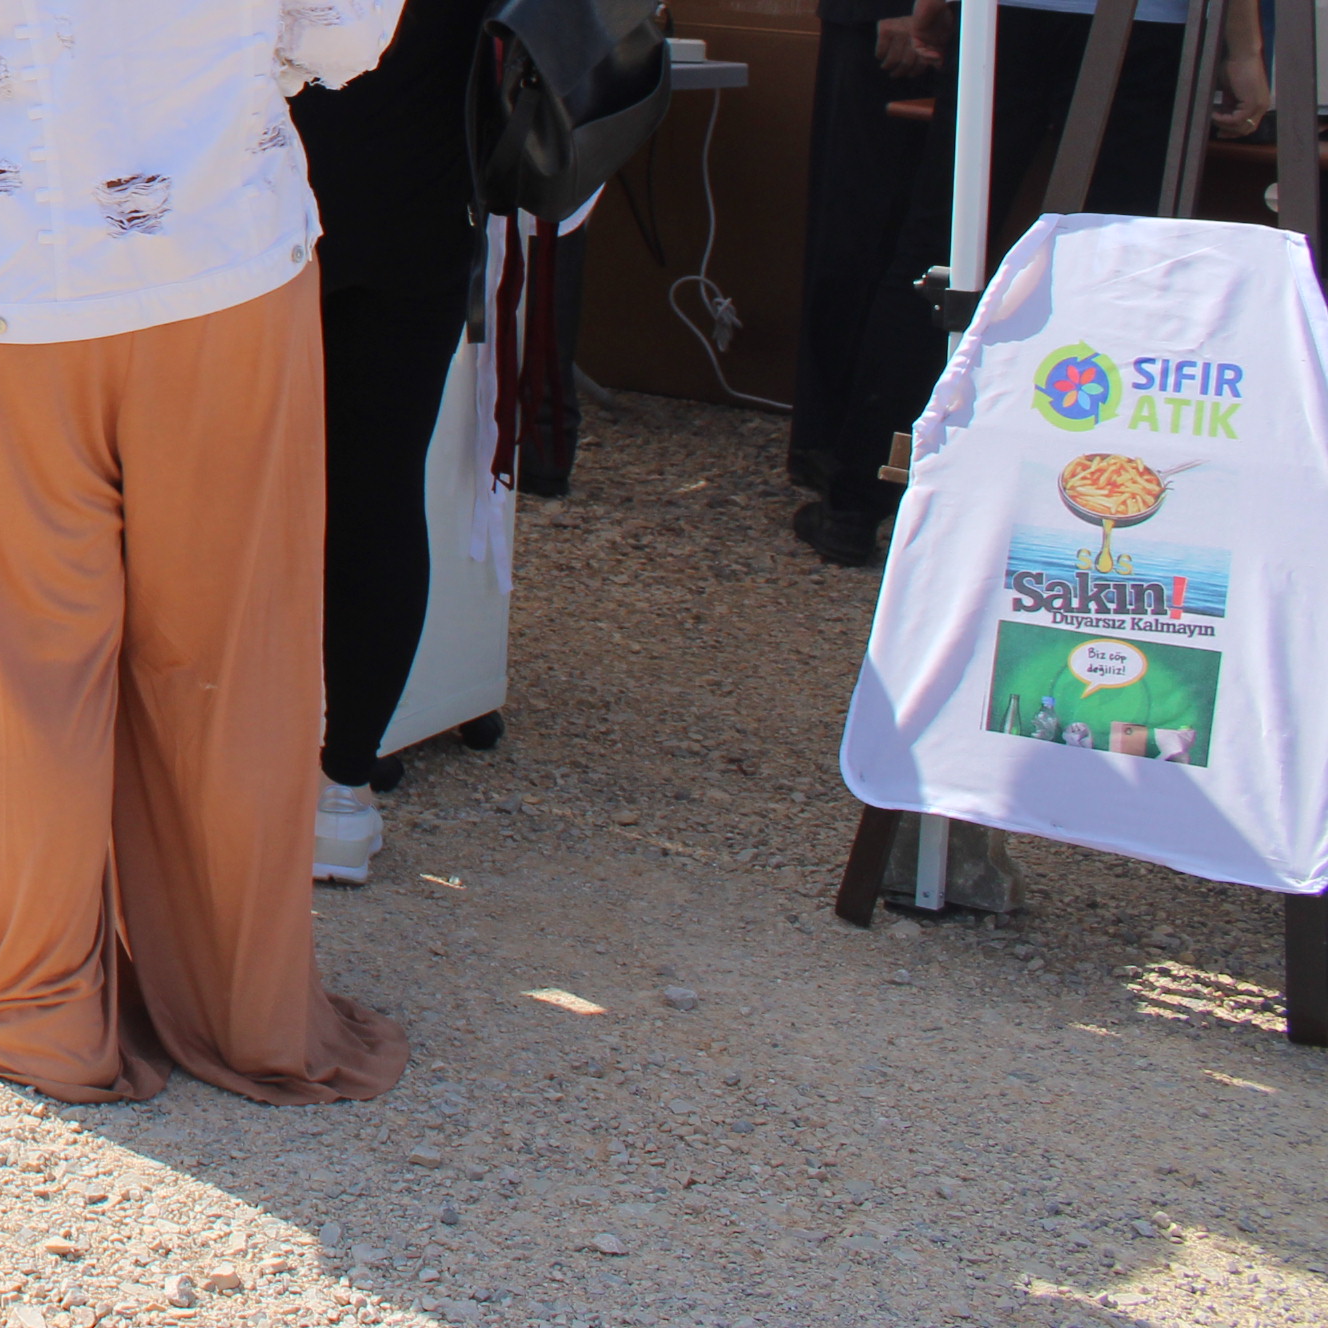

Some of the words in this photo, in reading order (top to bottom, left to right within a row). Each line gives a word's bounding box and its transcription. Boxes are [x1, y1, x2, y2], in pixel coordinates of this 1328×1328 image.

[1131, 357, 1243, 398] SIFIR
[1128, 395, 1242, 440] ATIK
[1012, 571, 1188, 621] Sakın!
[1051, 610, 1126, 631] Duyarsız
[1130, 617, 1215, 638] Kalmayın
[1088, 647, 1106, 660] Biz
